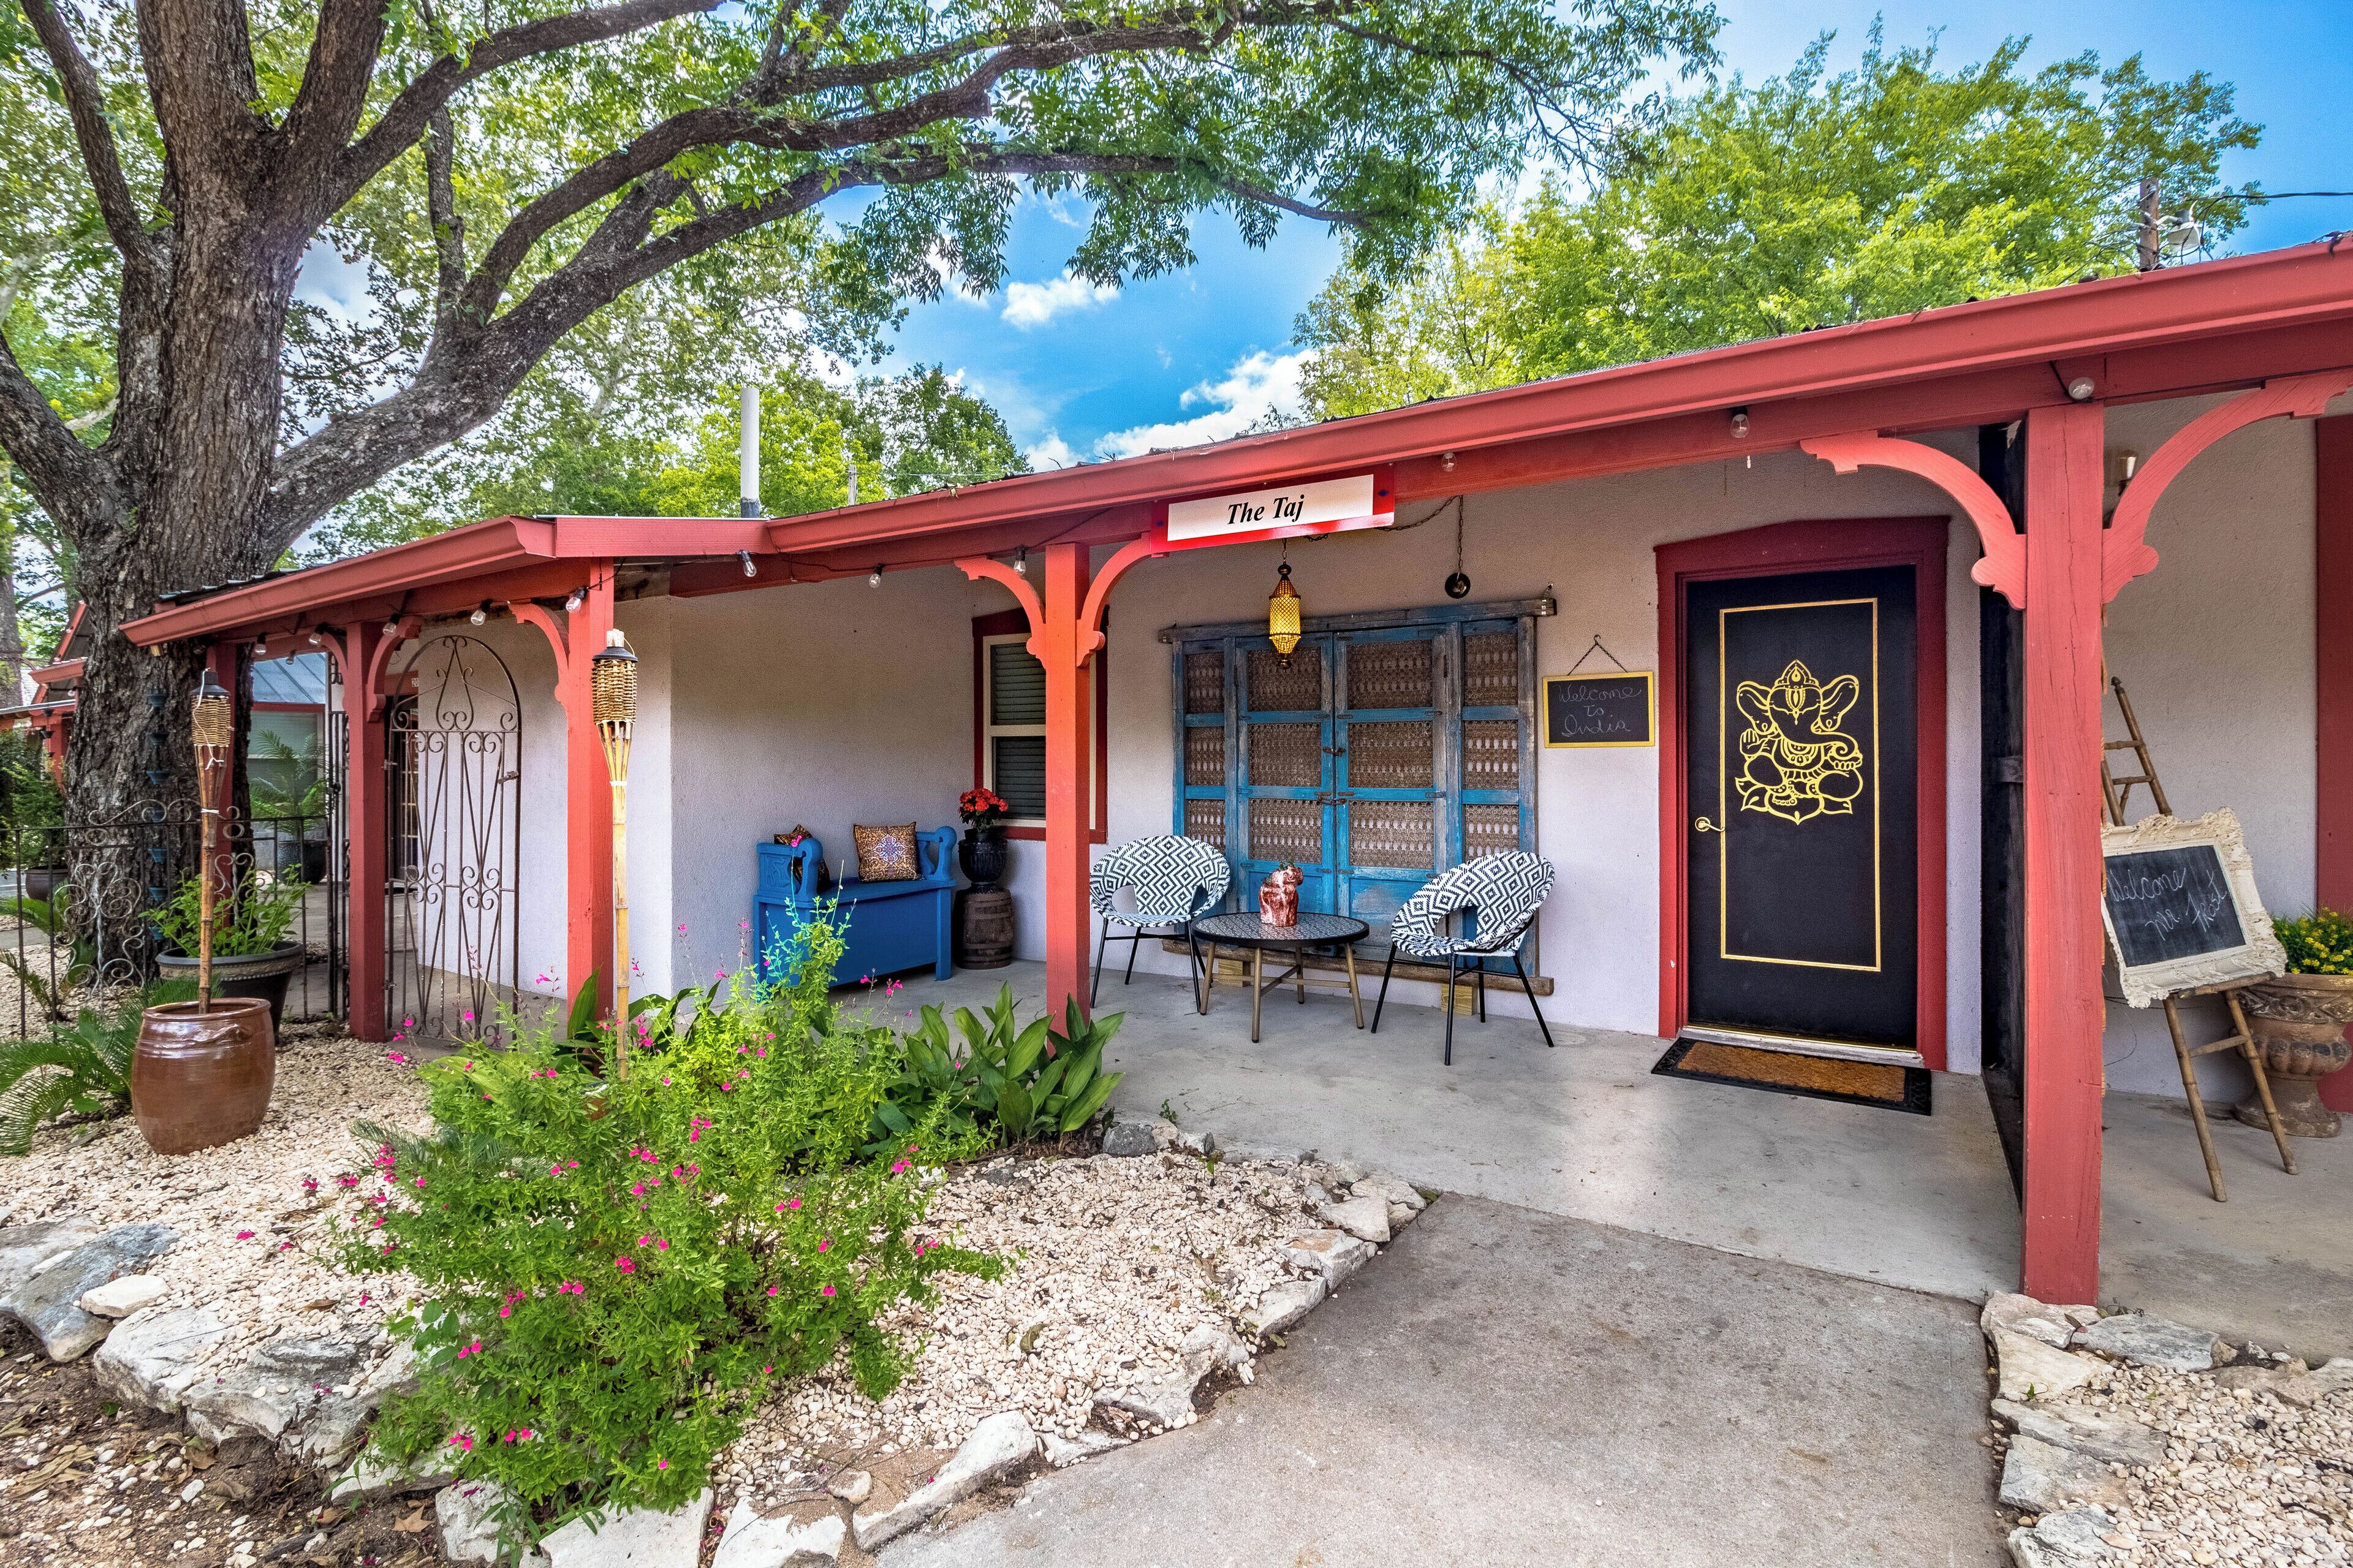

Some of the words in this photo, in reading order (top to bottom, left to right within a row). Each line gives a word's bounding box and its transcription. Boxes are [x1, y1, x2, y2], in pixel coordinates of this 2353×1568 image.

[1227, 502, 1265, 525] The
[1273, 494, 1305, 522] Taj
[1553, 684, 1642, 702] Welcome
[1561, 714, 1631, 737] India
[2106, 868, 2186, 902] Welcome
